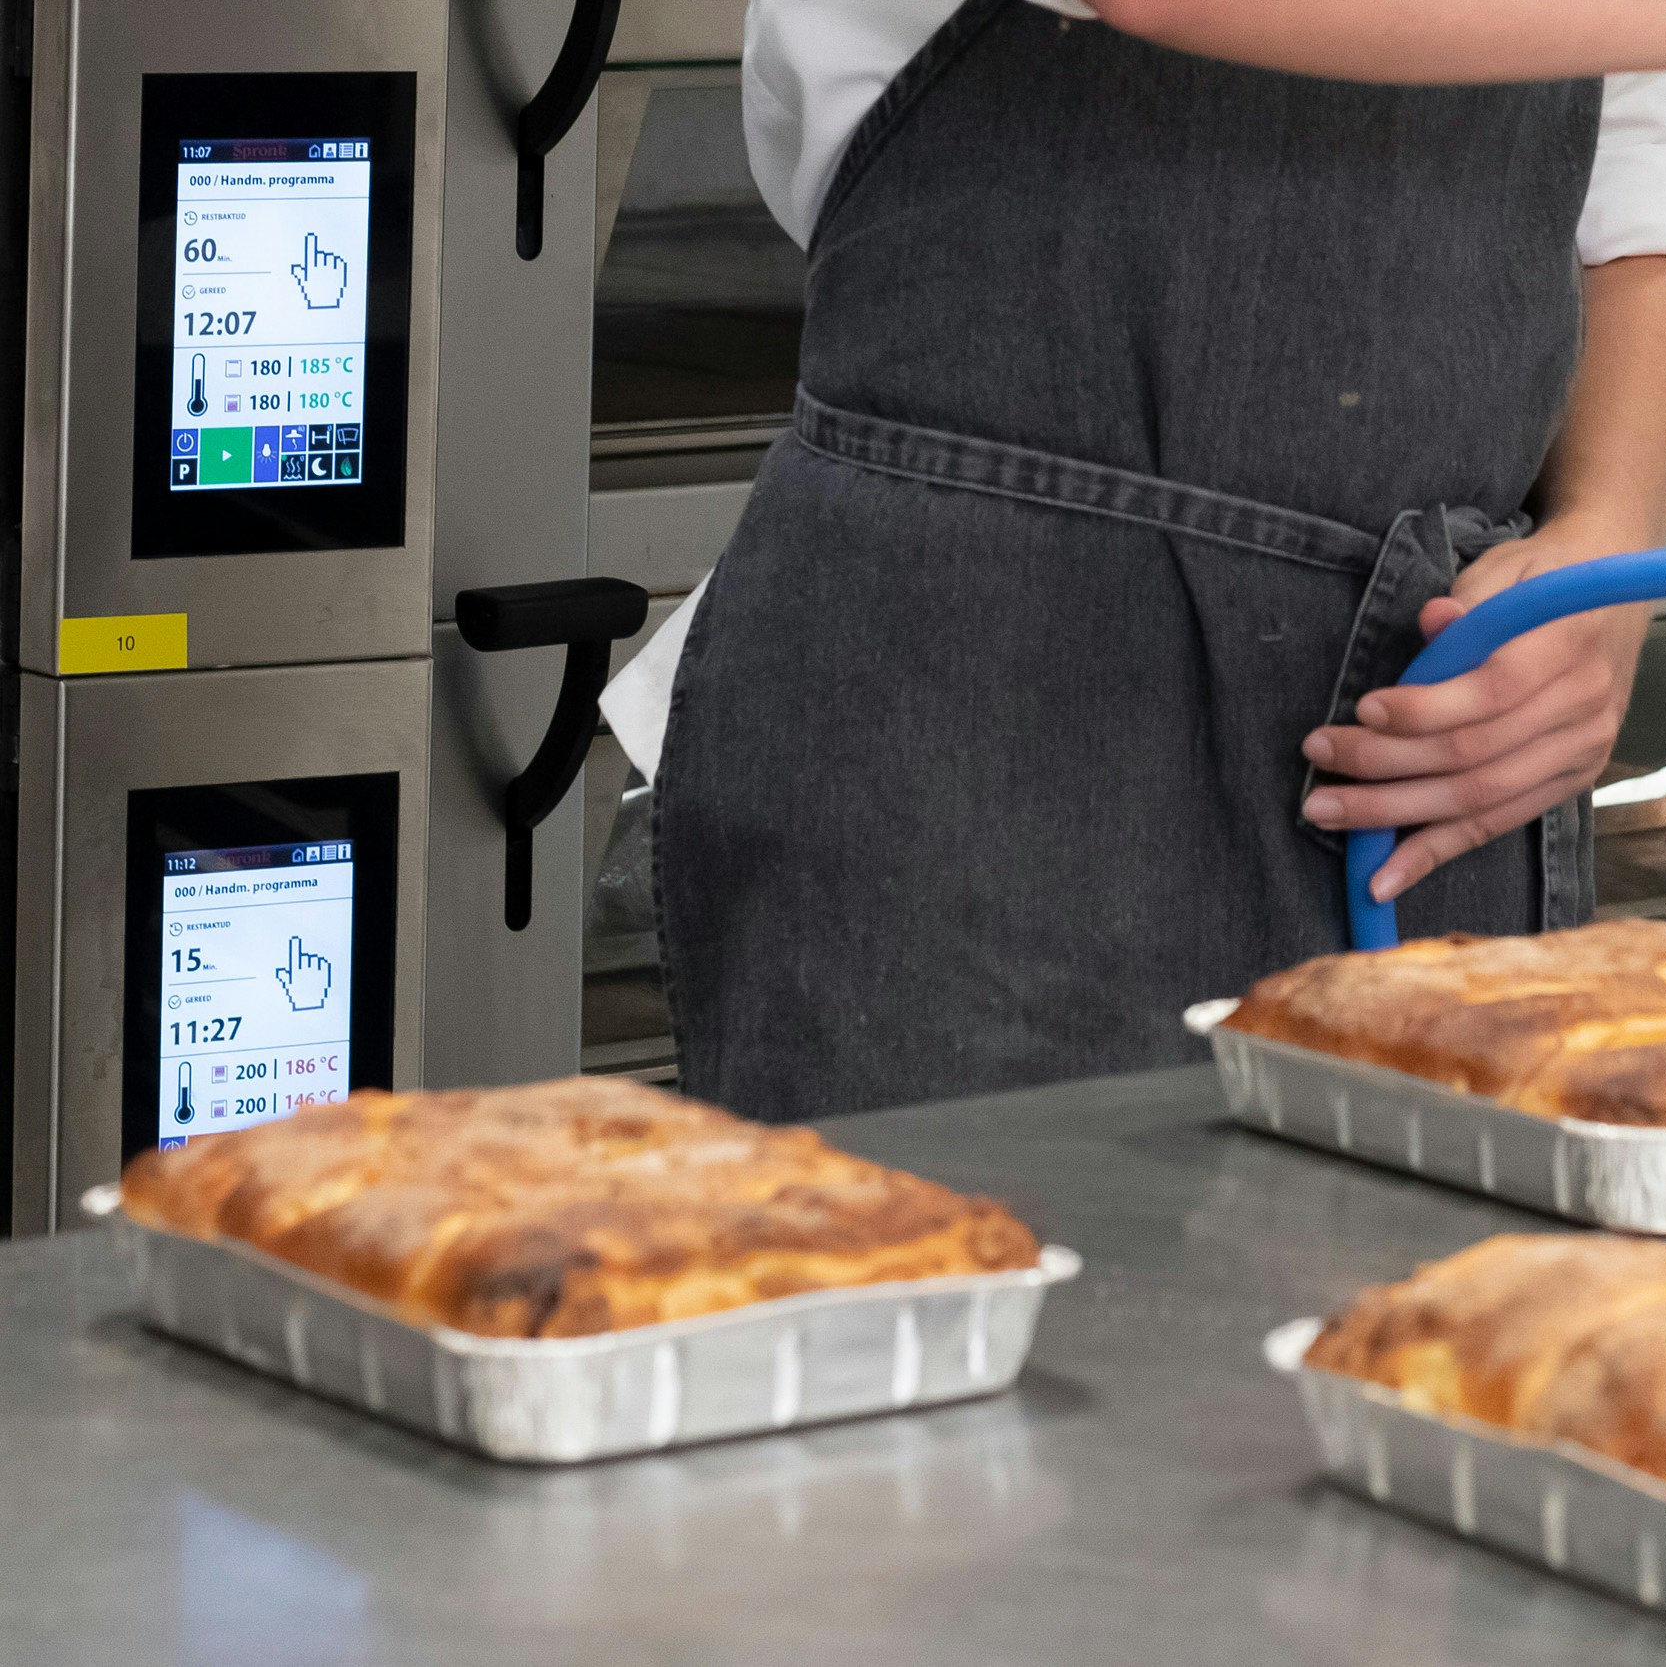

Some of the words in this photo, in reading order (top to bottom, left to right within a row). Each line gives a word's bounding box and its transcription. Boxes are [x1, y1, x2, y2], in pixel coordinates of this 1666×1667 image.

[183, 146, 212, 159] 11:07
[189, 175, 211, 186] 000
[214, 175, 219, 187] /
[221, 174, 266, 186] Handm.
[269, 175, 335, 187] programma
[184, 238, 217, 263] 60
[217, 255, 232, 263] Min.
[199, 287, 226, 295] GEREED
[184, 311, 257, 336] 12:07
[250, 359, 281, 376] 180
[300, 358, 330, 374] 185
[335, 357, 353, 373] °C
[250, 394, 280, 411] 180
[299, 392, 330, 409] 180
[334, 391, 353, 408] °C
[117, 635, 135, 651] 10
[167, 858, 196, 871] 11:12
[174, 886, 196, 898] 000
[198, 884, 203, 897] /
[205, 882, 250, 896] Handm.
[253, 878, 318, 894] programma
[171, 948, 201, 973] 15
[203, 963, 218, 971] Min.
[185, 995, 212, 1004] GEREED
[170, 1017, 242, 1045] 11:27
[235, 1063, 267, 1080] 200
[286, 1059, 316, 1075] 186
[320, 1055, 338, 1071] °C
[235, 1097, 266, 1114] 200
